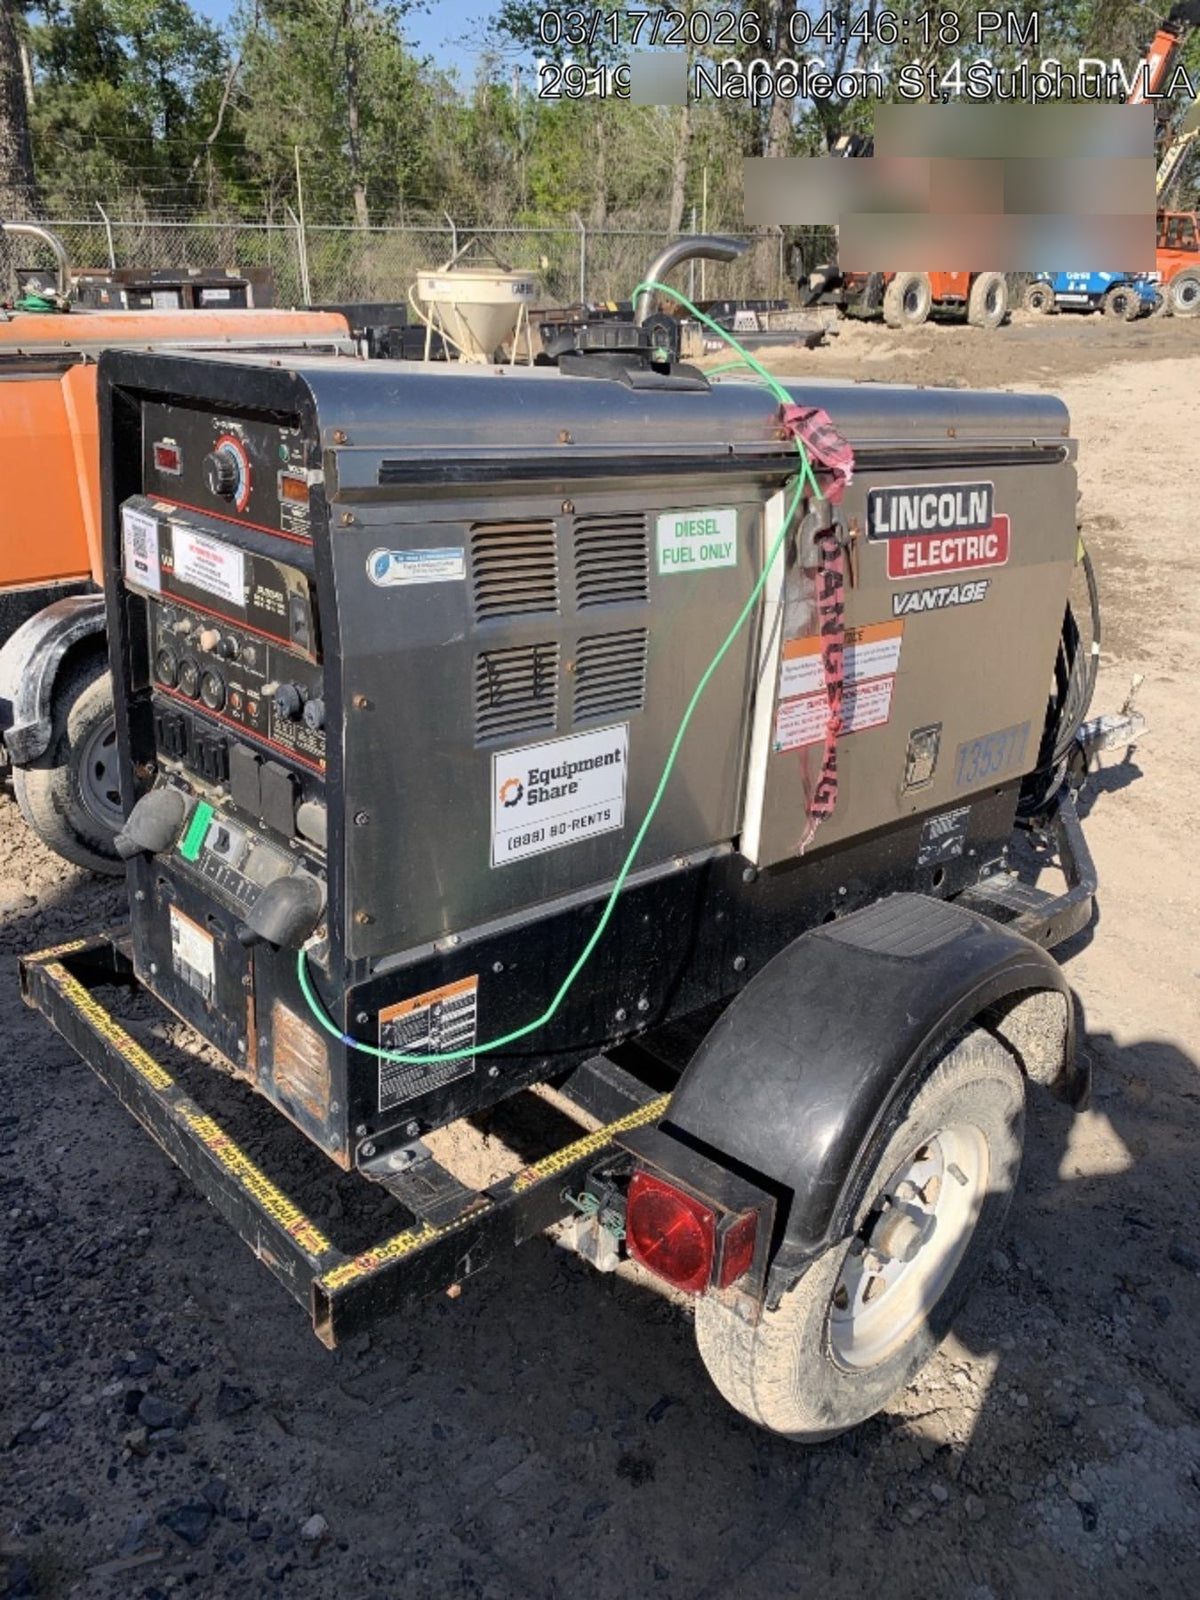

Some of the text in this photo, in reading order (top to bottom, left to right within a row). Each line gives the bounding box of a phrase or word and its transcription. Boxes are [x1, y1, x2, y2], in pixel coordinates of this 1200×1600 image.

[674, 518, 721, 538] DIESEL
[874, 490, 988, 534] LINCOLN
[662, 541, 733, 565] FUEL ONLY
[902, 534, 999, 570] ELECTRIC
[892, 580, 990, 617] VANTAGE
[527, 748, 621, 786] Equipment
[526, 781, 579, 806] Share
[507, 808, 611, 851] (888) 80-RENTS
